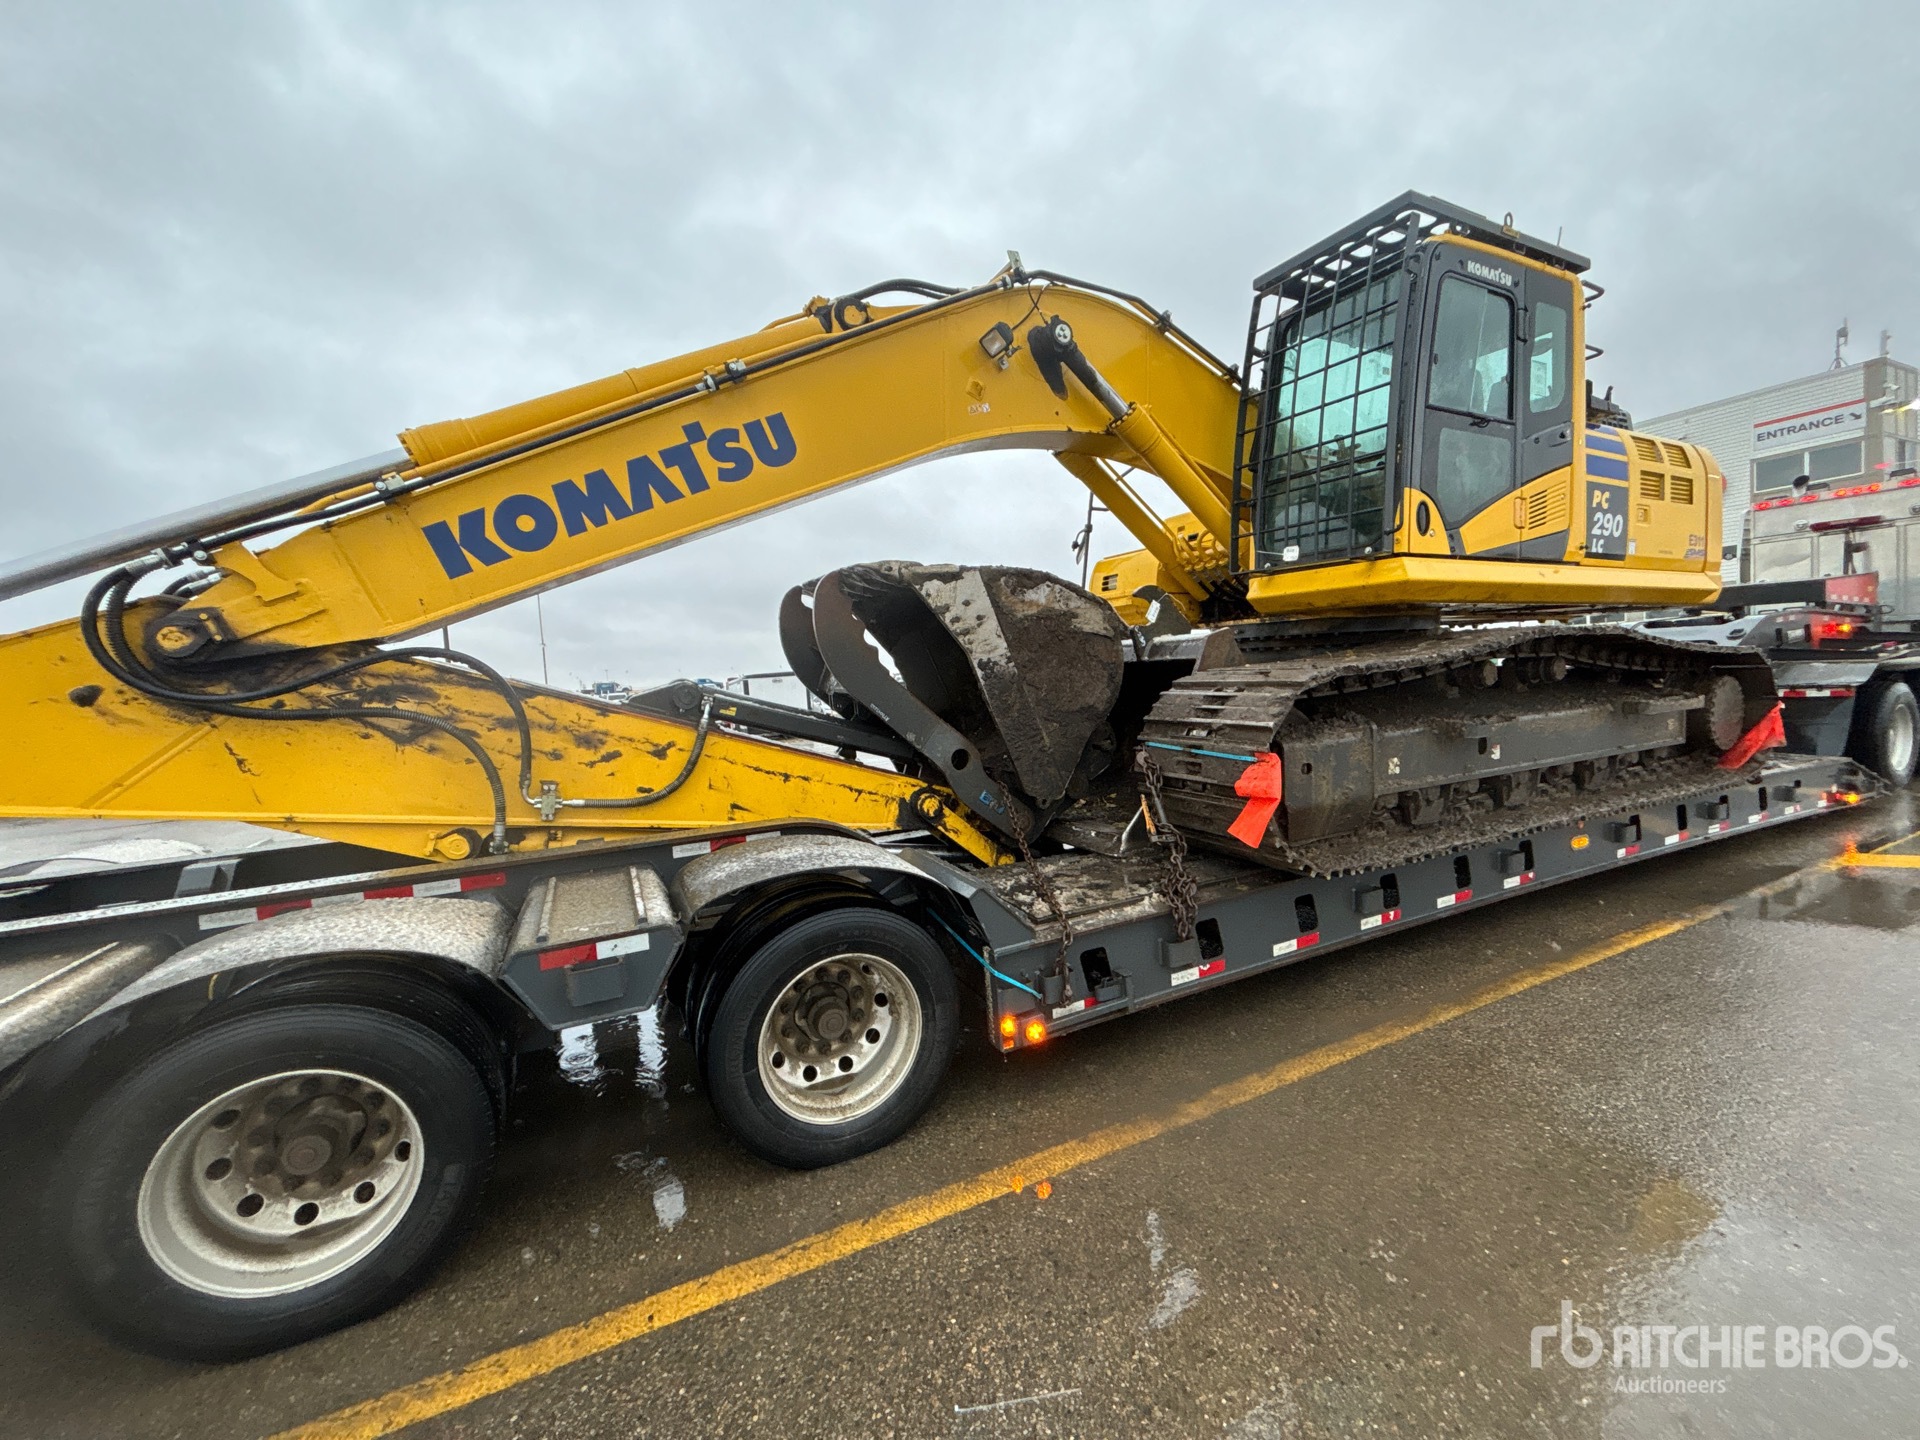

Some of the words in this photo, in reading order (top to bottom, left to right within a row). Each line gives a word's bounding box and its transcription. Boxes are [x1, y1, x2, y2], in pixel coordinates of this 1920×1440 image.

[1467, 260, 1512, 287] KOMATSU
[1757, 414, 1844, 441] ENTRANCE
[421, 411, 797, 580] KOMATSU
[1592, 489, 1610, 509] PC
[1591, 511, 1624, 538] 290
[1591, 538, 1605, 553] LC
